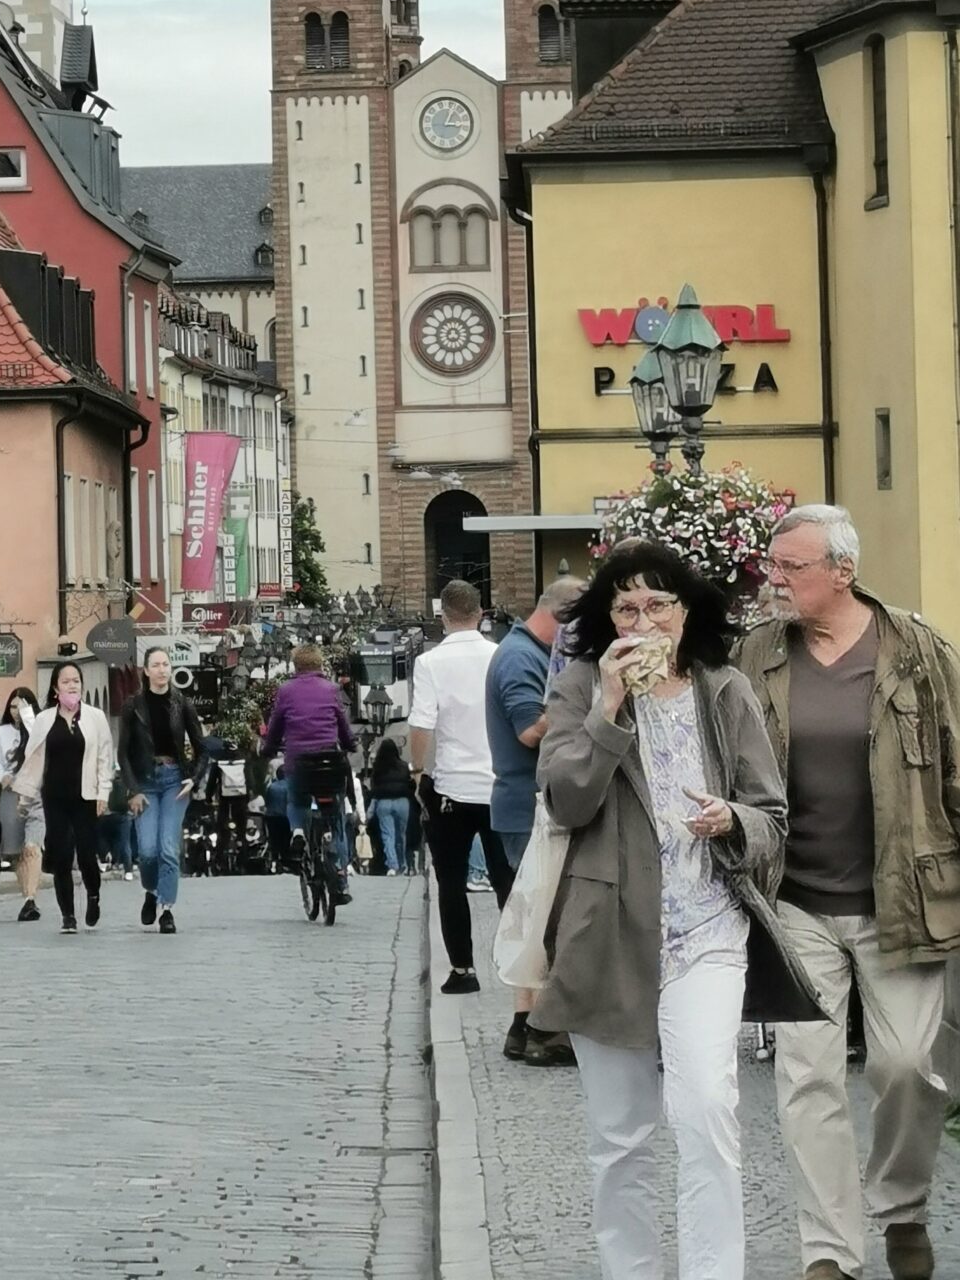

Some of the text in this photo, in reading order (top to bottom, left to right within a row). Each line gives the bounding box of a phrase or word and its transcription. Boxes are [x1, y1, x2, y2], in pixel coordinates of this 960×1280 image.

[578, 297, 790, 345] WÖRL
[593, 362, 779, 397] PZA
[185, 461, 209, 558] Schlier
[281, 493, 292, 587] APOTHEKE
